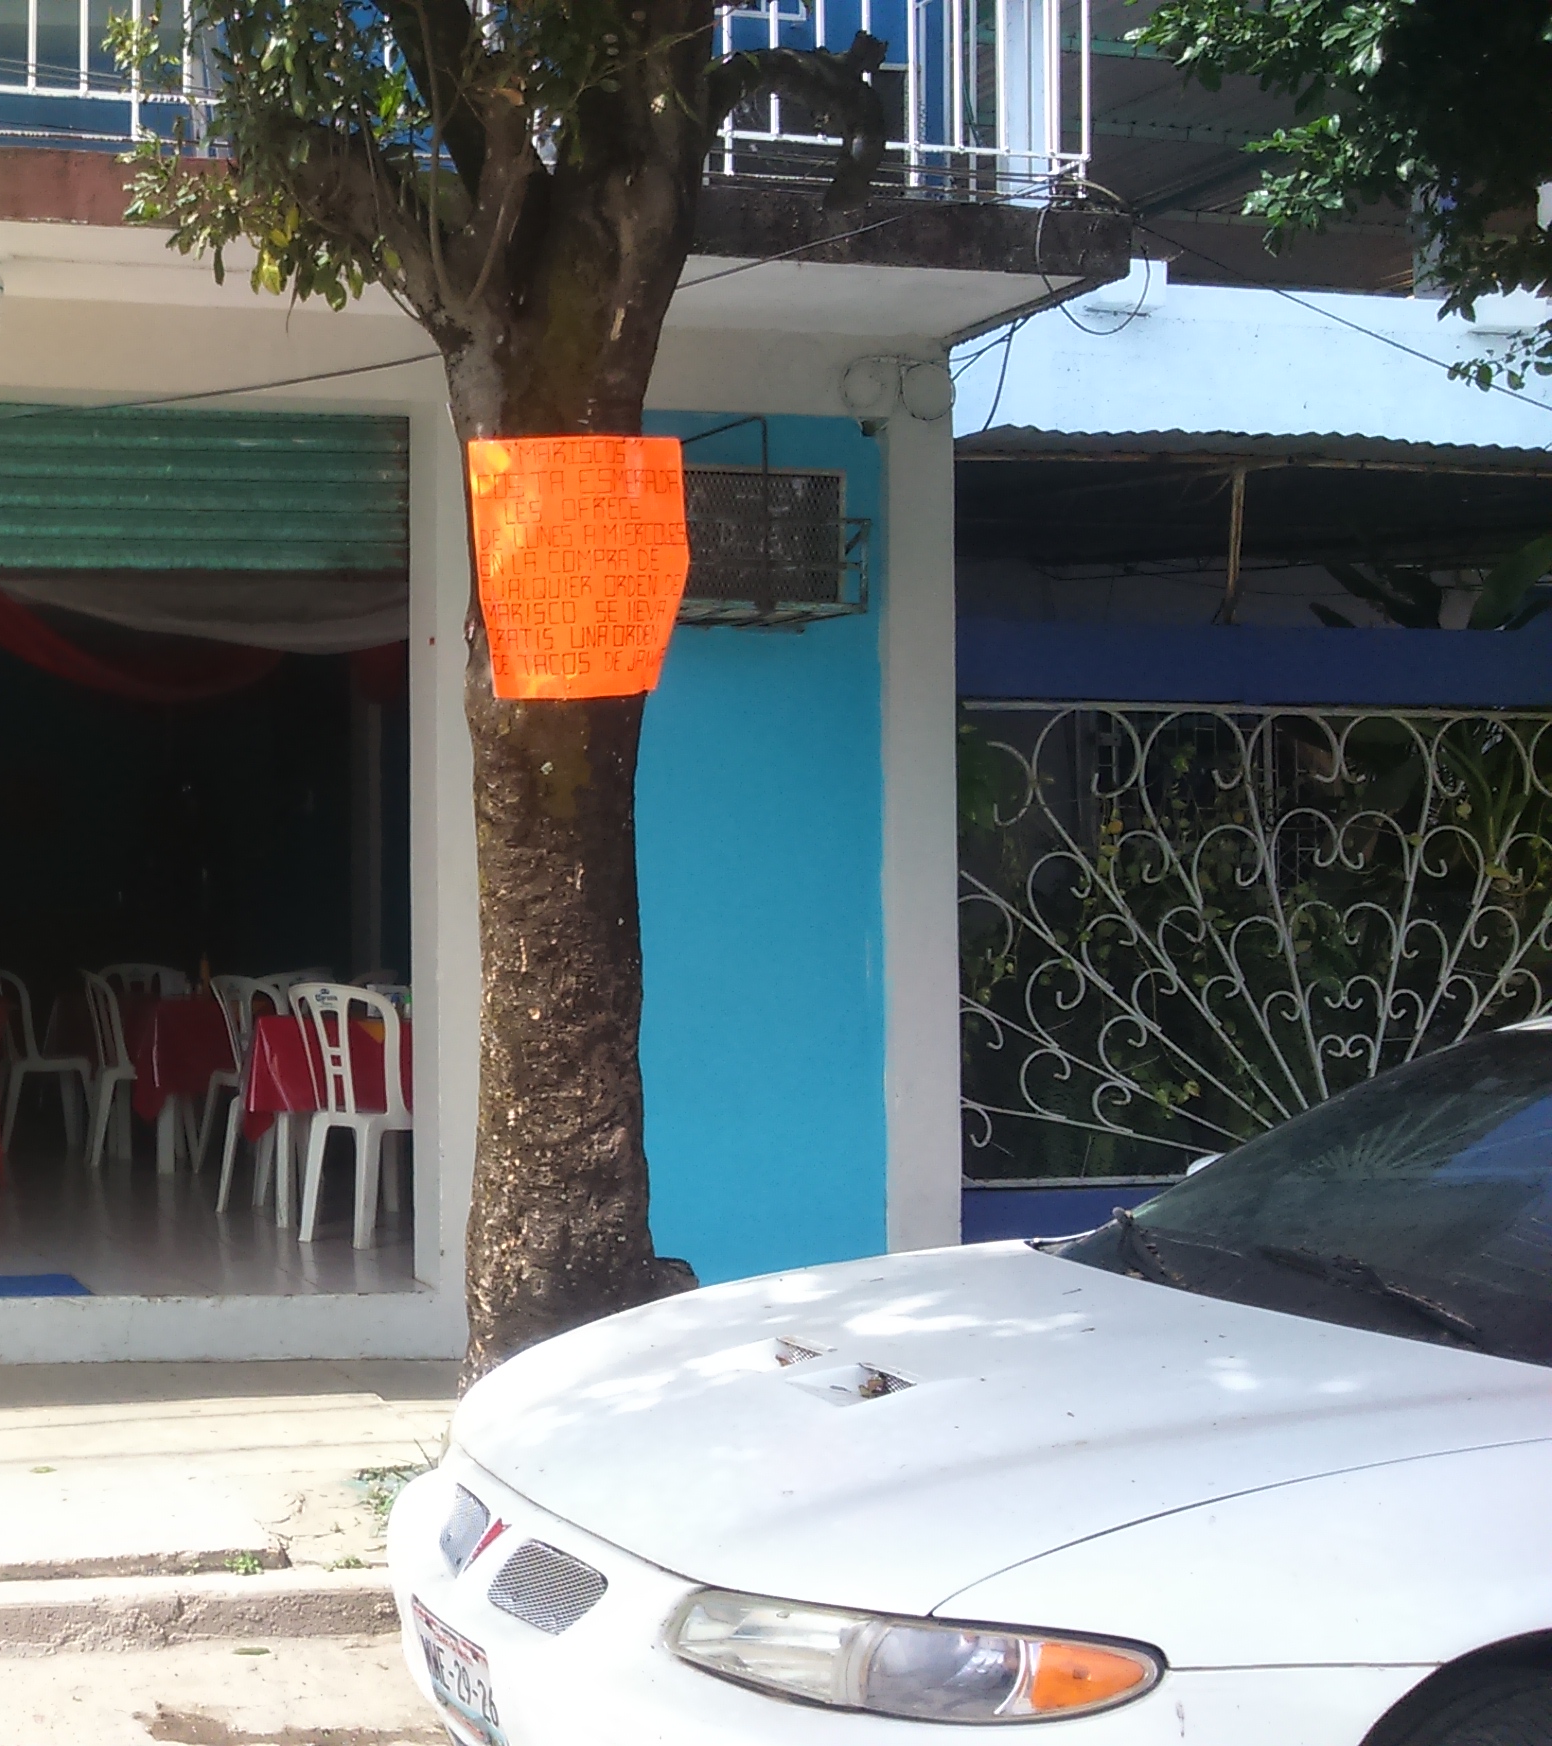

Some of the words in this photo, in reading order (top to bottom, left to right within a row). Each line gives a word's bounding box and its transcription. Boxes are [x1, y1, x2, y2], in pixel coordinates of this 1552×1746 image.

[477, 470, 565, 499] COSTA
[504, 500, 543, 525] LES
[562, 497, 641, 522] OFRECE
[480, 529, 503, 550] DE
[513, 525, 573, 549] LUNES
[583, 524, 597, 545] A
[480, 554, 505, 577] EN
[512, 552, 536, 575] LA
[549, 549, 629, 574] COMPRA
[638, 548, 660, 571] DE
[482, 576, 592, 601] CUALQUIER
[604, 574, 658, 598] ORDEN
[665, 573, 682, 596] DE
[483, 601, 577, 625] MARISCO
[595, 600, 618, 624] SE
[570, 625, 608, 649] UNA
[613, 624, 660, 648] ORDEN
[492, 654, 510, 676] DE
[517, 652, 591, 676] TACOS
[604, 651, 623, 672] DE
